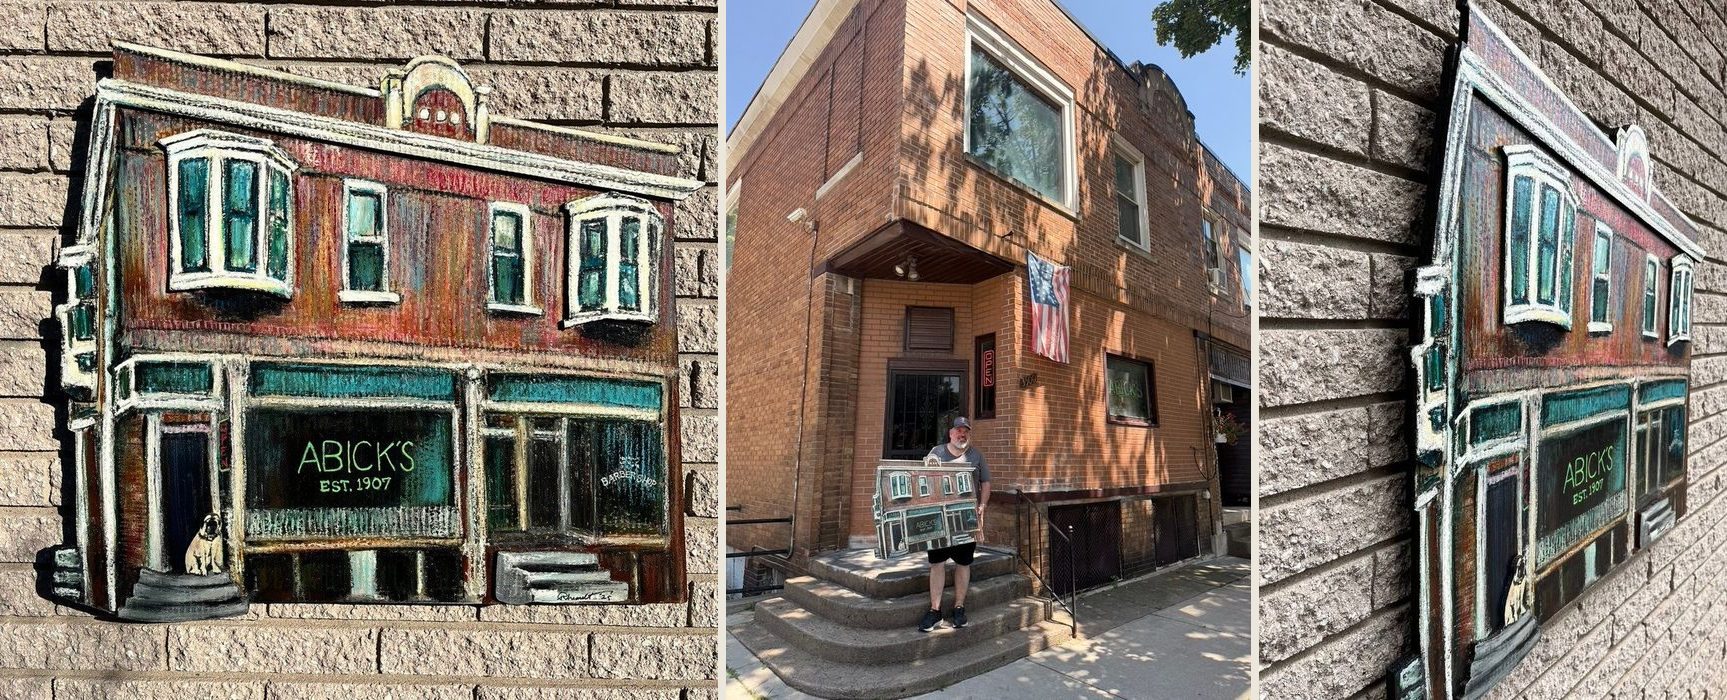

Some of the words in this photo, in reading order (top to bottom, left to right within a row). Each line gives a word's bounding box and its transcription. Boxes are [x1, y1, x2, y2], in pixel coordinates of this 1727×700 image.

[985, 352, 993, 385] OPEN
[297, 440, 415, 474] ABICK'S
[1562, 445, 1613, 494] ABICK'S
[319, 479, 353, 493] EST.
[356, 476, 392, 491] 1907
[1573, 488, 1588, 505] EST.
[1589, 478, 1604, 496] 1907
